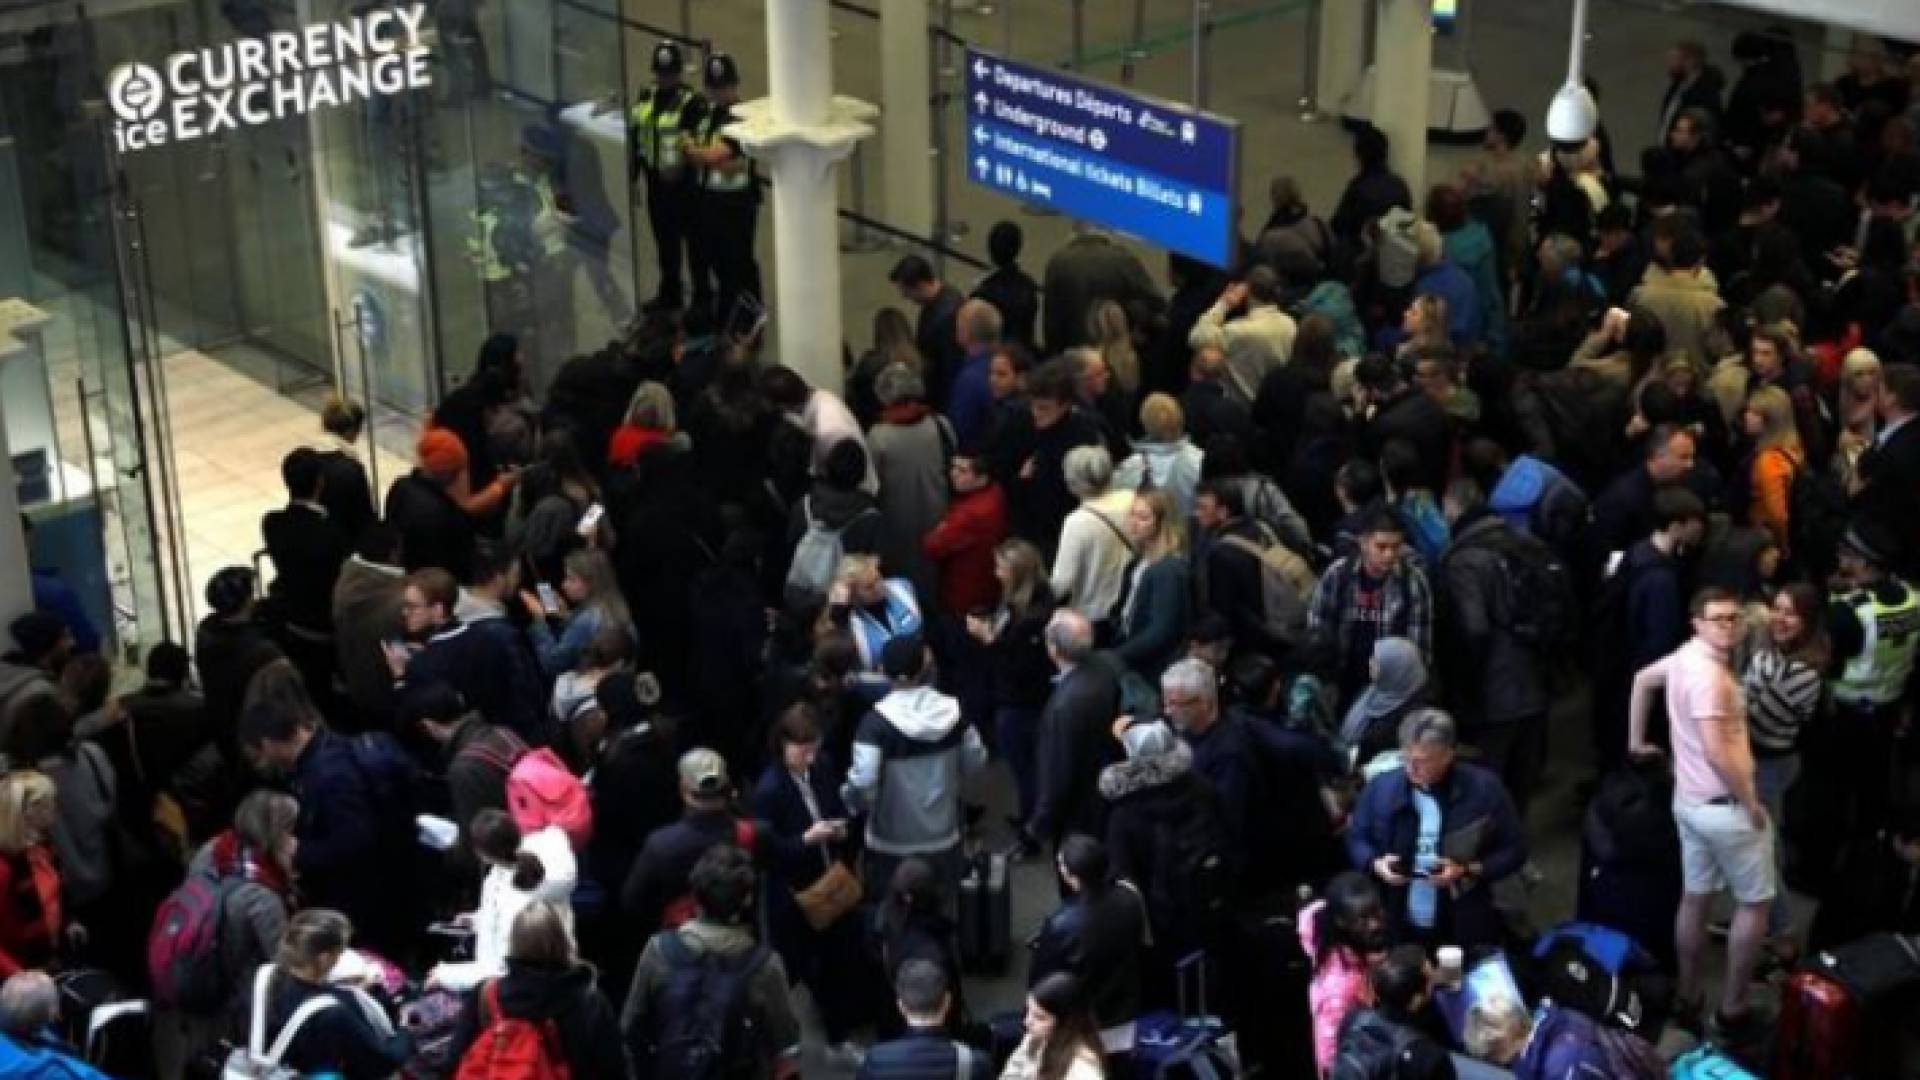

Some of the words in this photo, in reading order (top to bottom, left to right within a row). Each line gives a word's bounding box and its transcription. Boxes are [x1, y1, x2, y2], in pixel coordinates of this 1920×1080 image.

[166, 2, 428, 95] CURRENCY
[172, 46, 432, 141] EXCHANGE
[993, 63, 1073, 106] Departures
[113, 118, 168, 152] ice
[993, 98, 1087, 144] Underground
[993, 132, 1083, 176] International
[1084, 161, 1133, 193] tickets
[1135, 175, 1185, 209] Billets
